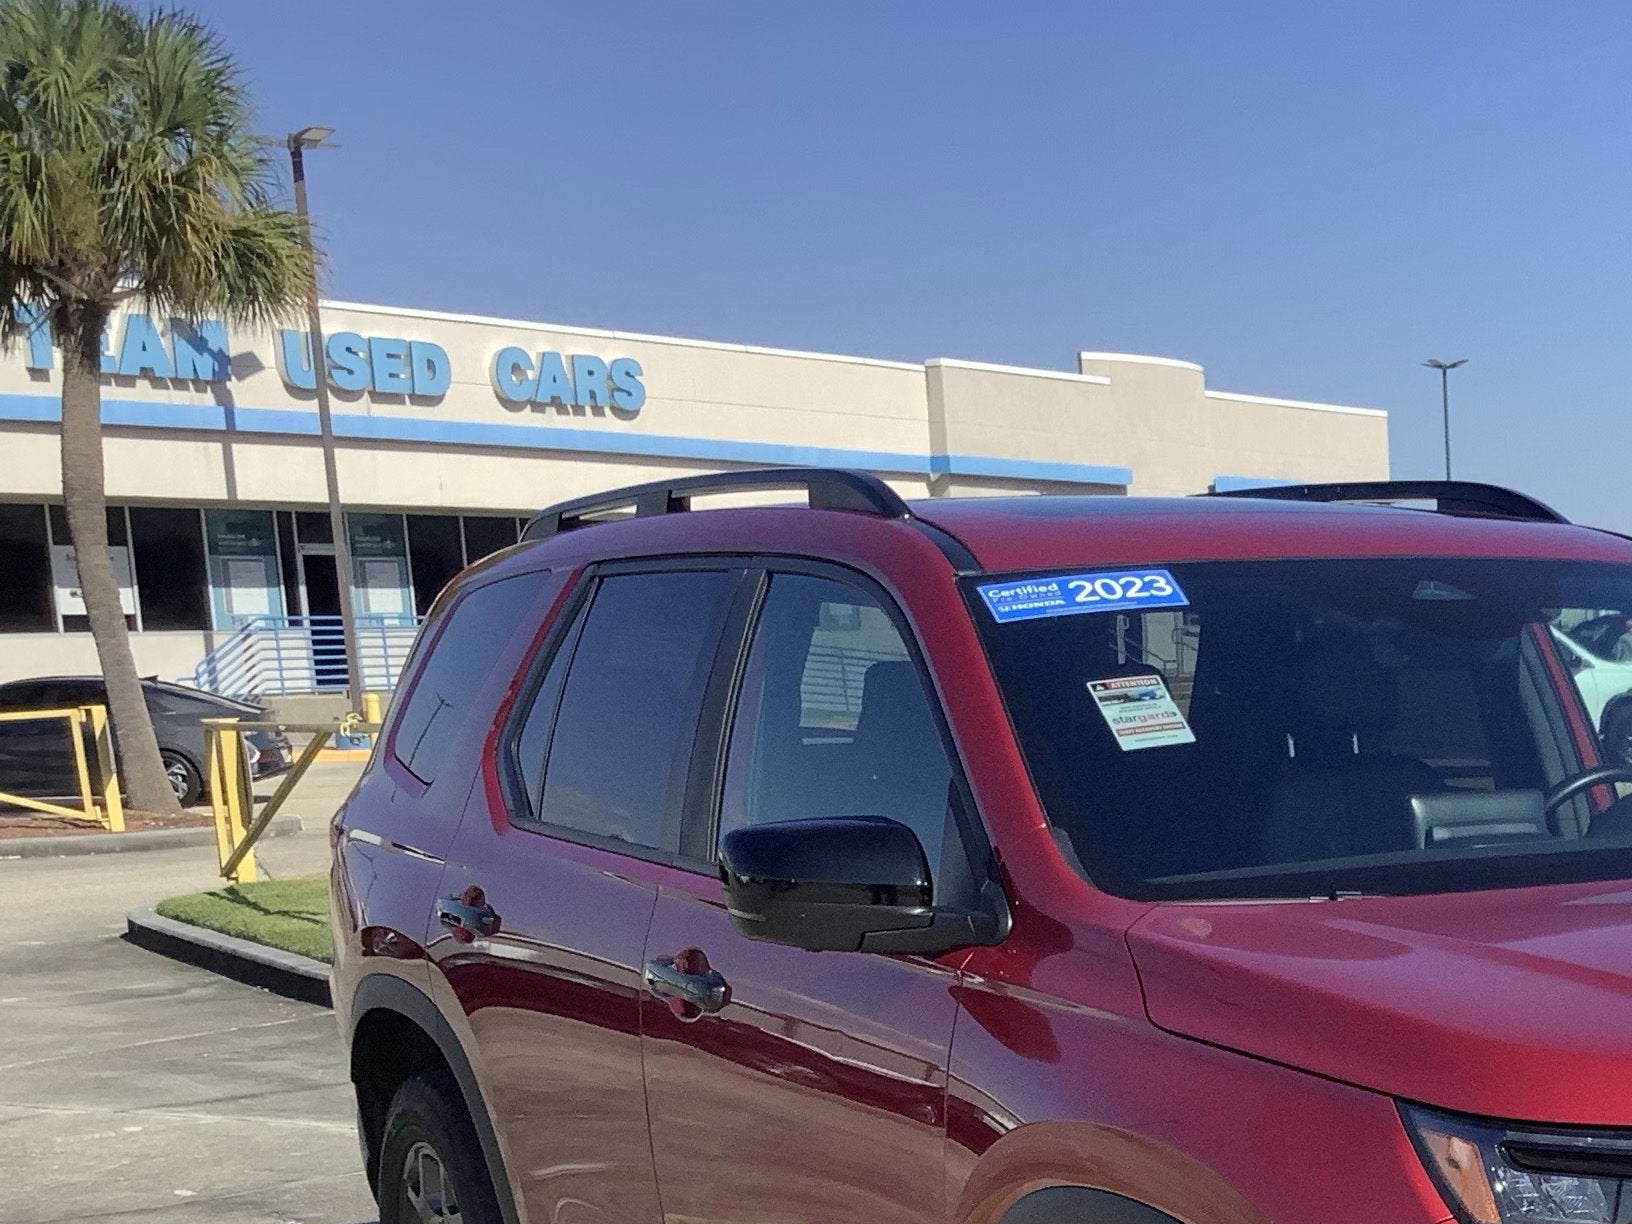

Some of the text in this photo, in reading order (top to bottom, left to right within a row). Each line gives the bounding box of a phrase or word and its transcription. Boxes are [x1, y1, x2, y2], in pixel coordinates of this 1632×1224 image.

[281, 328, 451, 396] USED
[495, 345, 646, 411] CARS
[988, 575, 1173, 602] Certified 2023
[1011, 600, 1067, 611] HONDA
[1110, 678, 1158, 689] ATTENTION
